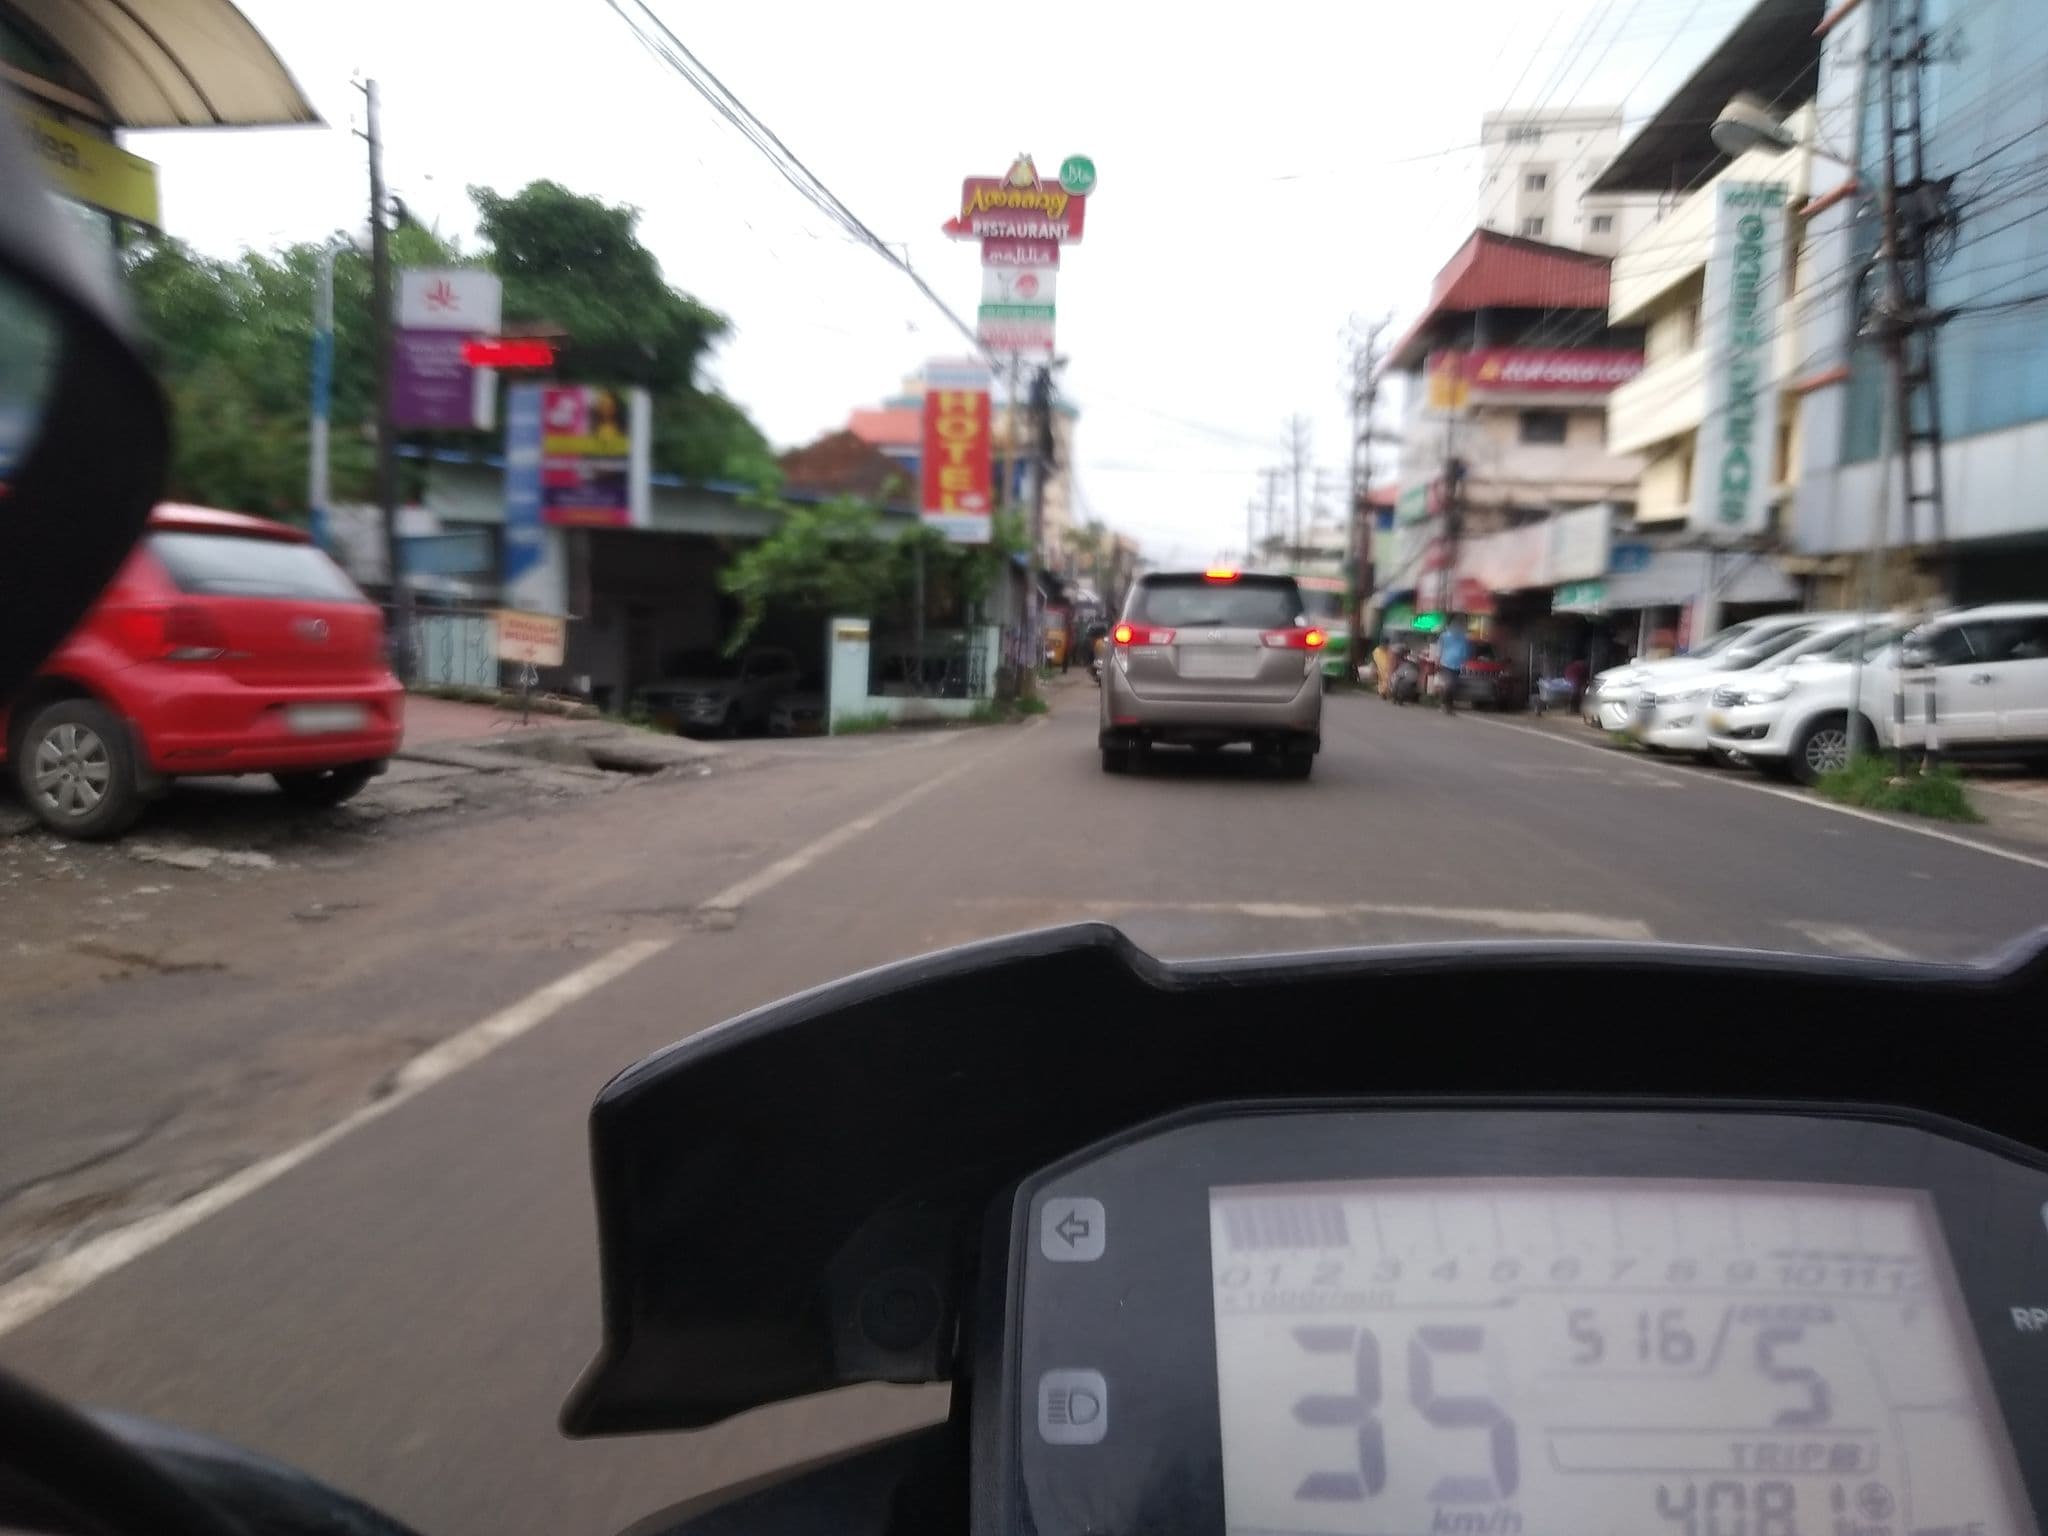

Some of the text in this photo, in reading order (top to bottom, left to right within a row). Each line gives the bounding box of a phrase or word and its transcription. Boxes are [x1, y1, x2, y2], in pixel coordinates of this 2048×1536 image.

[971, 221, 1070, 241] RESTAURANT
[936, 390, 981, 515] HOTEL
[1289, 1324, 1520, 1501] 35
[1431, 1507, 1522, 1536] km/h
